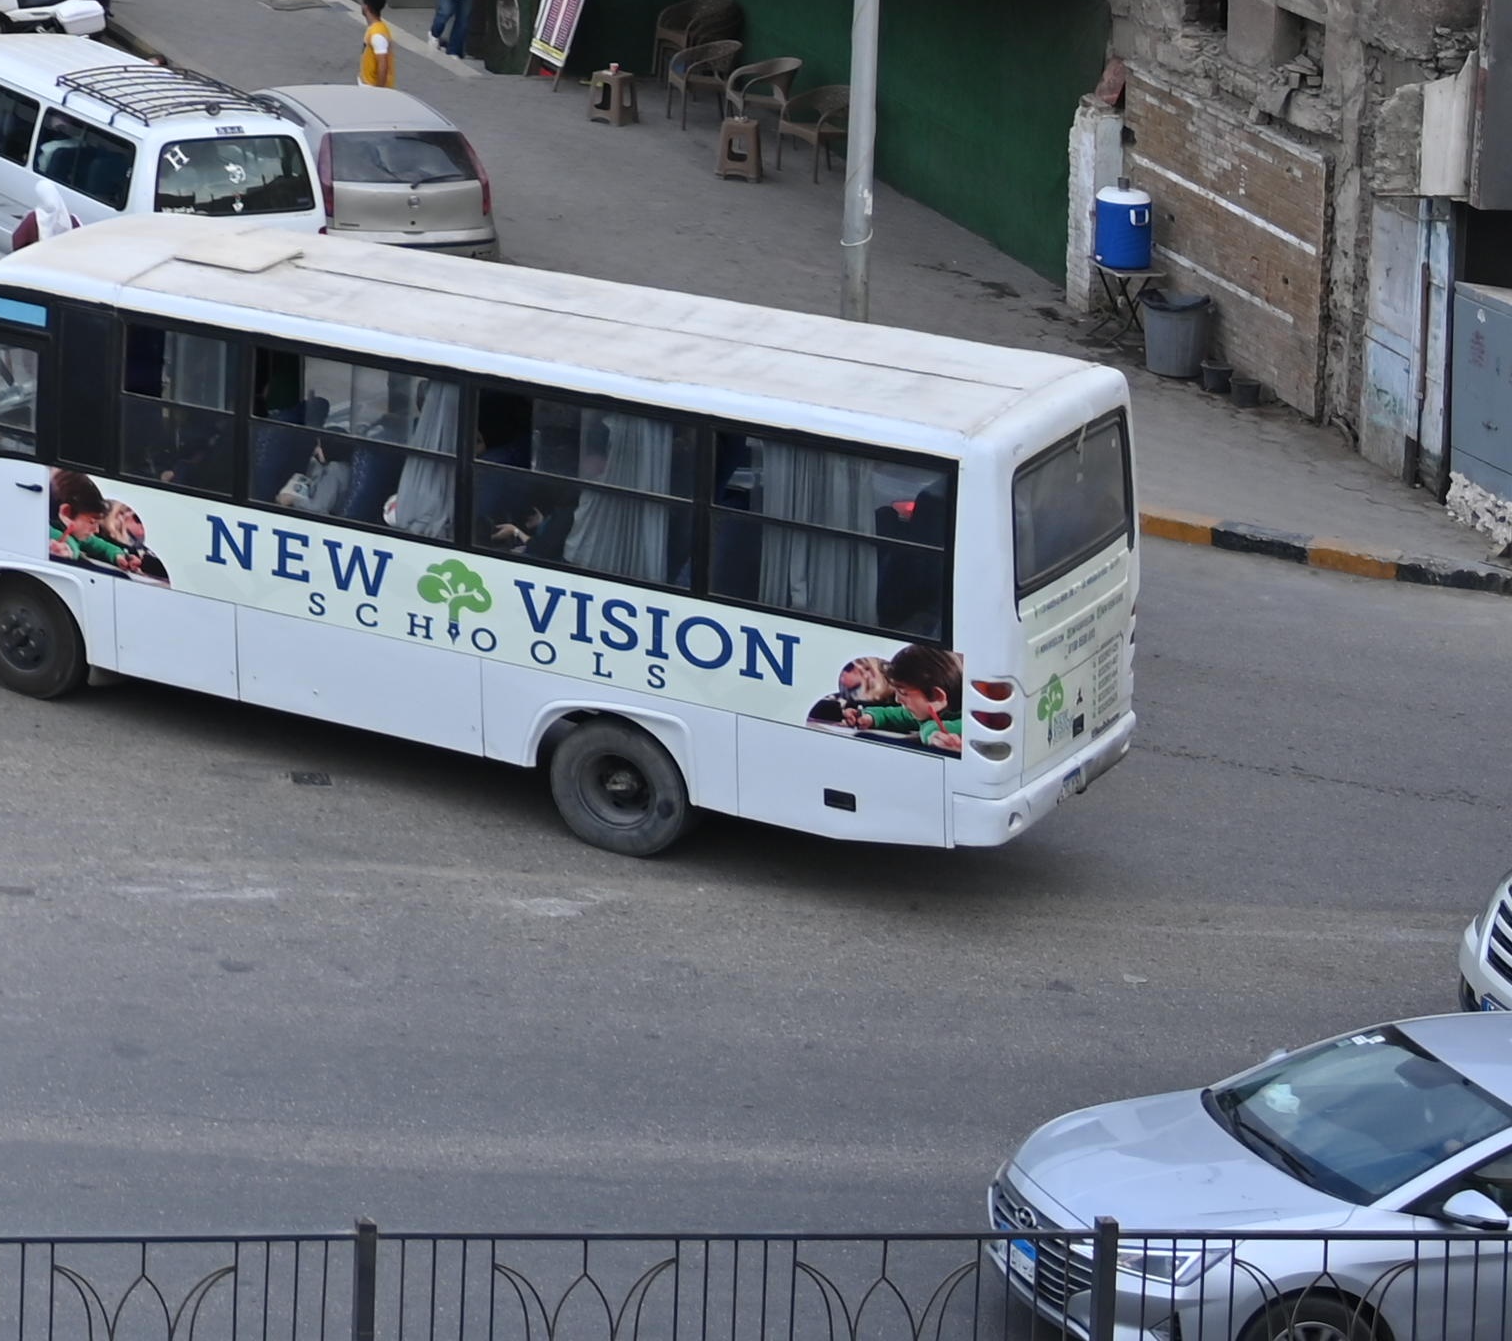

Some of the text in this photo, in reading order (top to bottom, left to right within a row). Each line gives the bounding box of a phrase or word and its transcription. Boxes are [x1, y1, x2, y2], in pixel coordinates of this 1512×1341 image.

[205, 514, 800, 687] NEW VISION
[308, 591, 667, 690] SCHOOLS
